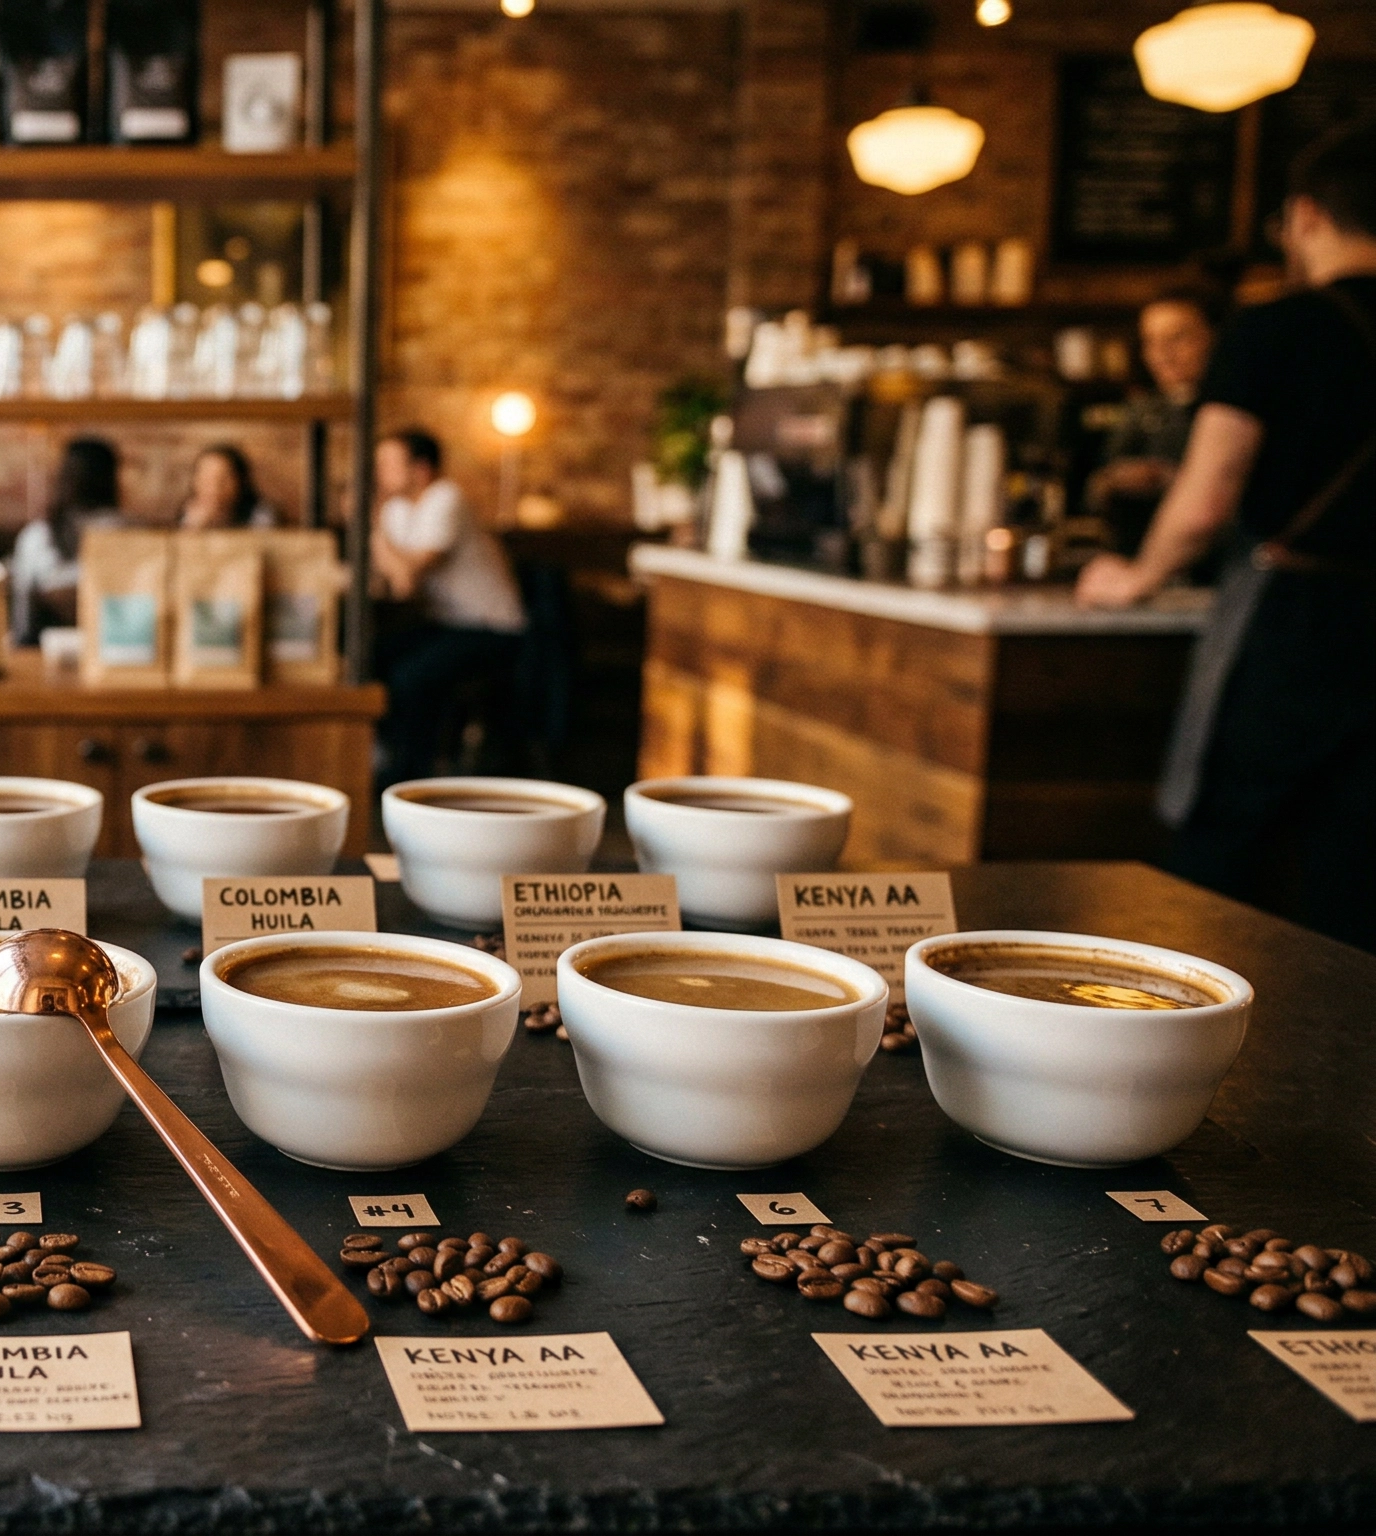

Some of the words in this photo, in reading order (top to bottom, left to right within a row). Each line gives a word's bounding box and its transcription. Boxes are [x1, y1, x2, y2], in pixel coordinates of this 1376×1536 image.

[219, 886, 342, 907] COLOMBIA
[513, 881, 622, 902] ETHIOPIA
[793, 884, 876, 909] KENYA
[885, 884, 921, 906] AA
[251, 912, 315, 930] HUILA
[362, 1203, 415, 1219] #4
[768, 1201, 797, 1215] 6
[1133, 1198, 1168, 1213] 7
[403, 1346, 525, 1366] KENYA
[539, 1344, 586, 1362] AA
[847, 1343, 970, 1362] KENYA
[978, 1341, 1029, 1359] AA
